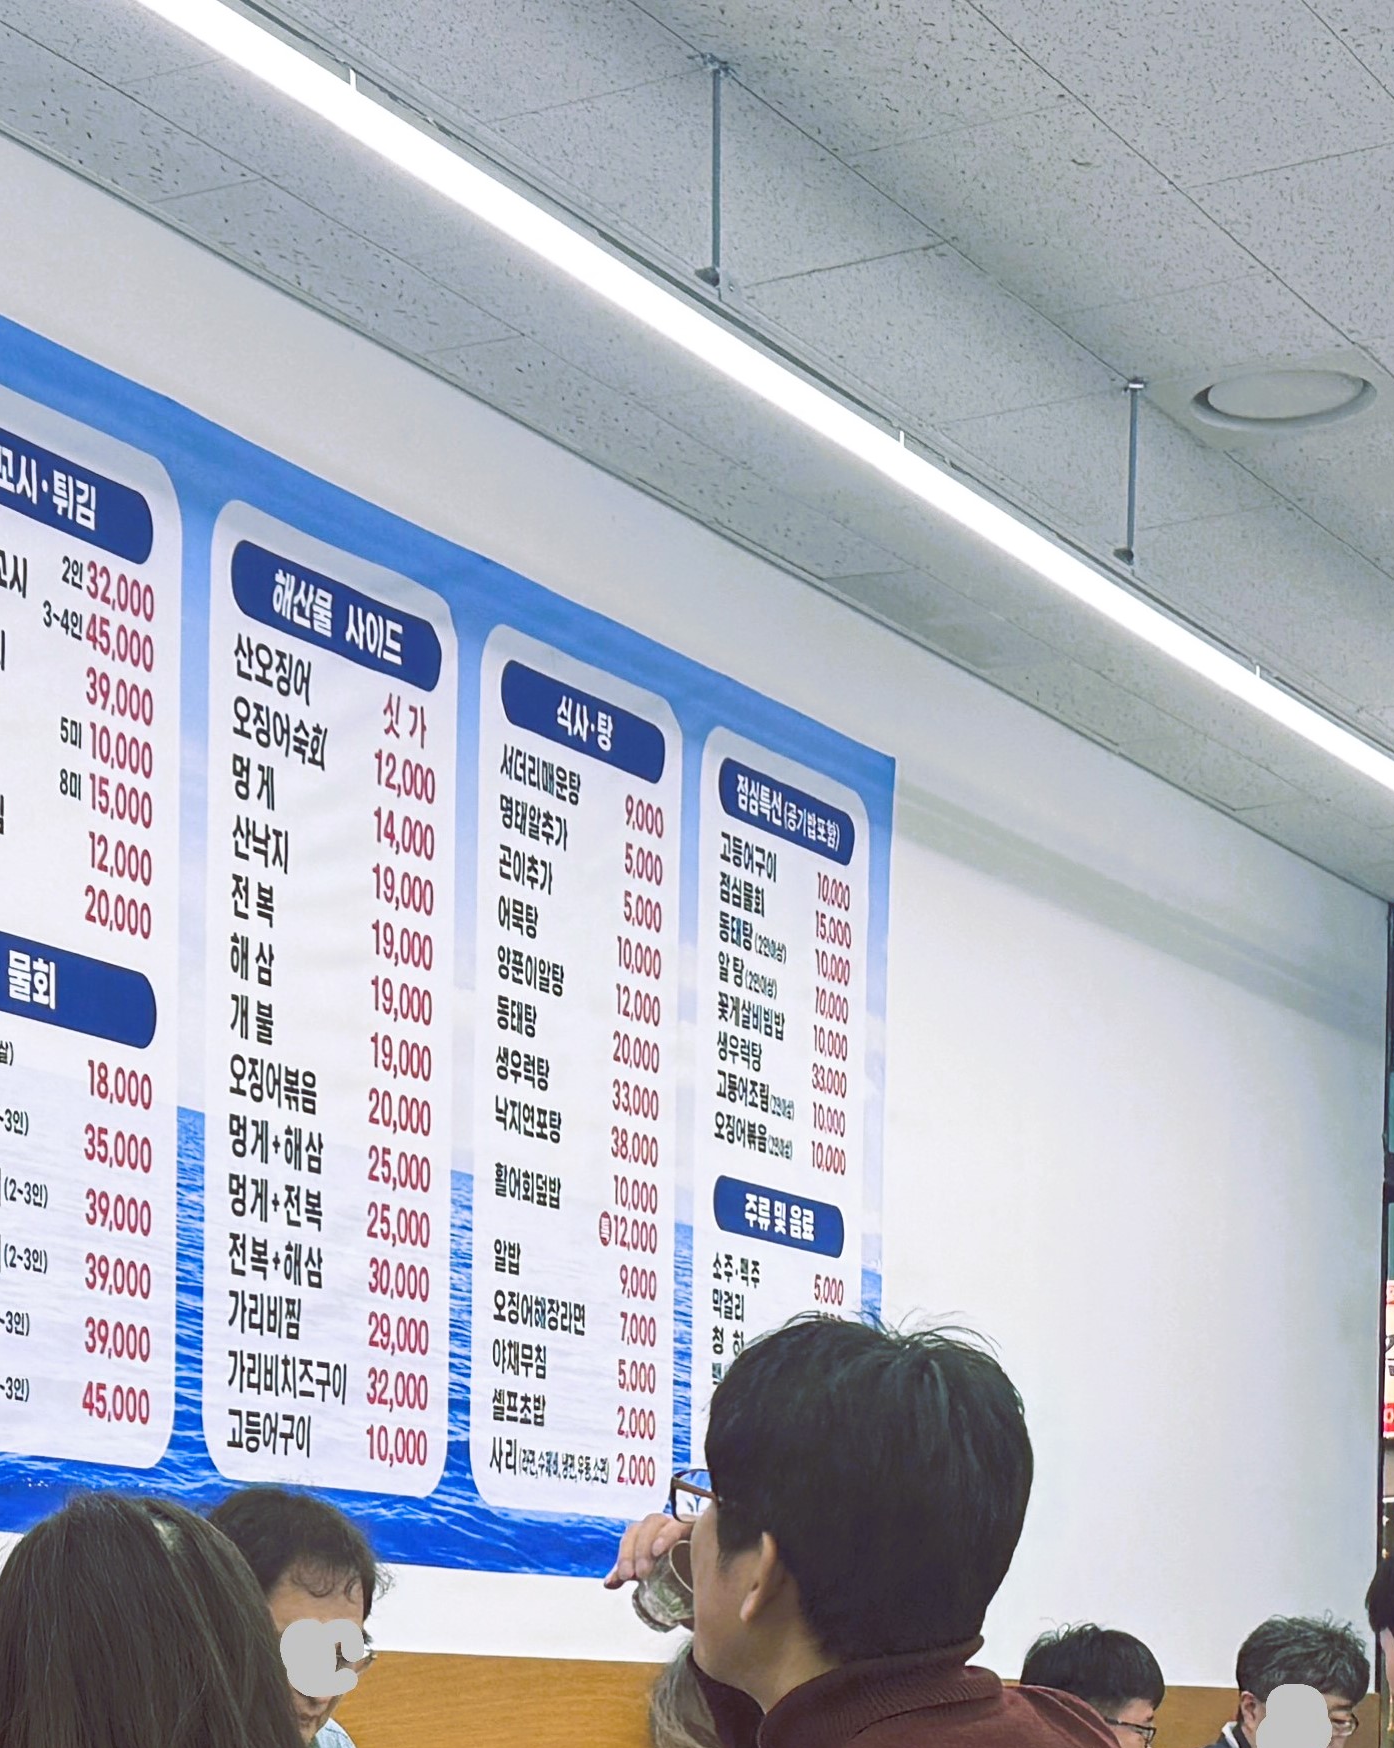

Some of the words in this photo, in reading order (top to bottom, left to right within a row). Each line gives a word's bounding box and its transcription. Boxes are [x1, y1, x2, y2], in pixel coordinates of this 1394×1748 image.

[62, 556, 82, 590] 2인
[86, 560, 155, 623] 32,000
[273, 570, 333, 638] 해산물
[345, 605, 403, 664] 사이드
[85, 616, 155, 672] 45,000
[235, 634, 311, 706] 산오징어
[86, 667, 154, 725] 39,000
[60, 717, 81, 748] 5미
[90, 723, 154, 778] 10,000
[233, 697, 327, 770] 오징어숙회
[375, 751, 434, 803] 12,000
[60, 769, 81, 799] 8미
[91, 775, 154, 828] 15,000
[501, 744, 580, 805] 서더리매운탕
[625, 795, 664, 839] 9,000
[90, 833, 154, 884] 12,000
[374, 810, 435, 860] 14,000
[233, 816, 288, 874] 산낙지
[372, 865, 434, 915] 19,000
[500, 845, 552, 895] 곤이추가
[623, 890, 662, 933] 5,000
[624, 842, 663, 885] 5,000
[84, 885, 152, 939] 20,000
[817, 871, 851, 912] 10,000
[372, 921, 434, 970] 19,000
[499, 896, 538, 938] 어묵탕
[617, 935, 662, 981] 10,000
[815, 910, 852, 950] 15,000
[8, 950, 55, 1009] 물회
[371, 976, 433, 1025] 19,000
[498, 946, 564, 996] 양푼이알탕
[615, 983, 660, 1026] 12,000
[370, 1034, 432, 1081] 19,000
[612, 1030, 660, 1073] 20,000
[813, 1024, 848, 1062] 10,000
[89, 1061, 154, 1110] 18,000
[230, 1054, 316, 1114] 오징어볶음
[367, 1087, 432, 1137] 20,000
[613, 1078, 659, 1120] 33,000
[812, 1062, 847, 1099] 33,000
[84, 1123, 154, 1173] 35,000
[230, 1114, 323, 1174] 멍게+해삼
[367, 1146, 431, 1193] 25,000
[496, 1096, 561, 1143] 낙지연포탕
[611, 1126, 659, 1168] 38,000
[86, 1189, 153, 1236] 39,000
[229, 1174, 322, 1231] 멍게+전복
[367, 1203, 432, 1248] 25,000
[495, 1163, 561, 1209] 활어회덮밥
[614, 1174, 657, 1215] 10,000
[613, 1214, 657, 1254] 12,000
[745, 1193, 770, 1228] 주류
[790, 1205, 814, 1242] 음료
[85, 1253, 151, 1298] 39,000
[229, 1233, 322, 1288] 전복+해삼
[368, 1257, 431, 1302] 30,000
[494, 1239, 520, 1275] 알밥
[619, 1263, 657, 1301] 9,000
[813, 1274, 843, 1305] 5,000
[85, 1317, 151, 1361] 39,000
[229, 1291, 301, 1340] 가리비찜
[368, 1312, 431, 1356] 29,000
[620, 1310, 657, 1348] 7,000
[229, 1350, 347, 1405] 가리비치즈구이
[366, 1367, 429, 1410] 32,000
[493, 1339, 547, 1379] 야채무침
[618, 1358, 656, 1394] 5,000
[81, 1382, 152, 1425] 45,000
[616, 1405, 656, 1441] 2,000
[228, 1409, 310, 1457] 고등어구이
[366, 1425, 429, 1466] 10,000
[616, 1453, 656, 1488] 2,000
